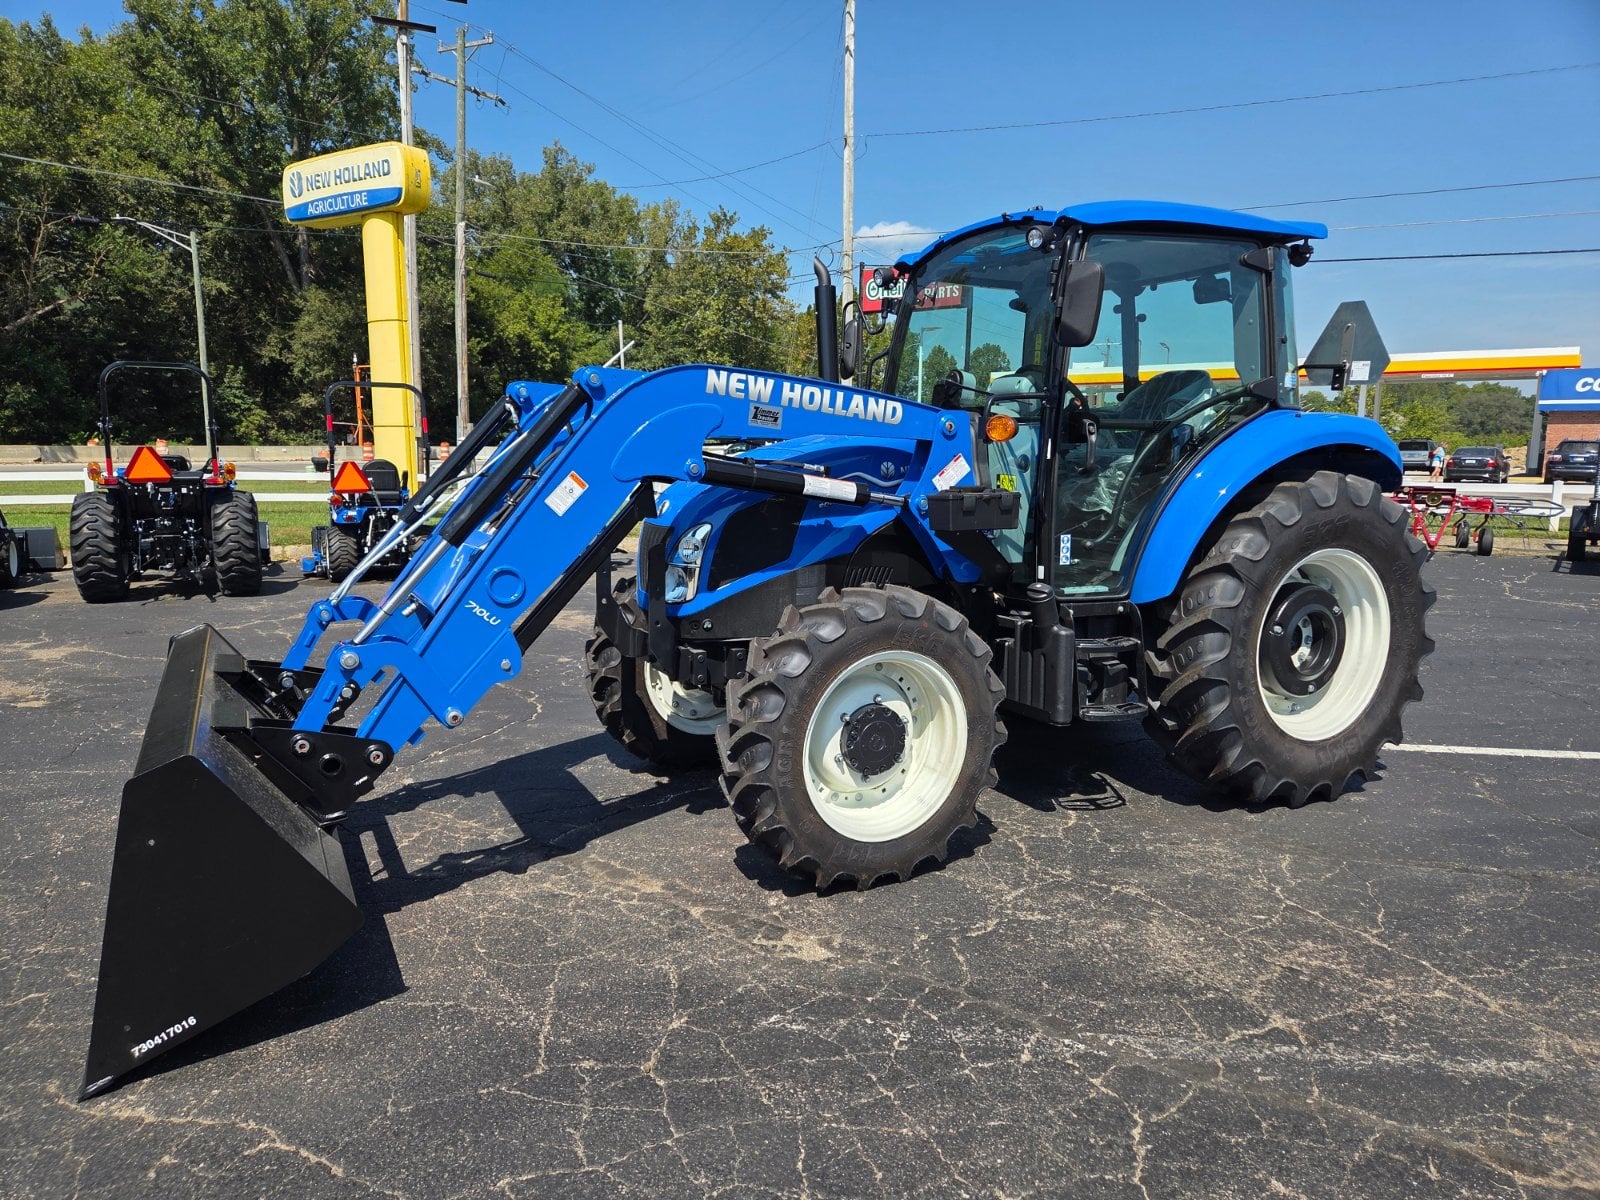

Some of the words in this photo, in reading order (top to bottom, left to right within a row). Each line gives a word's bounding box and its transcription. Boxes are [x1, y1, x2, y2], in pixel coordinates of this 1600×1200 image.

[305, 170, 331, 192] NEW
[334, 158, 391, 186] HOLLAND
[307, 192, 368, 216] AGRICULTURE
[705, 368, 775, 403] NEW
[780, 381, 903, 425] HOLLAND
[464, 600, 501, 626] 710LU
[130, 1015, 197, 1059] 730417016
